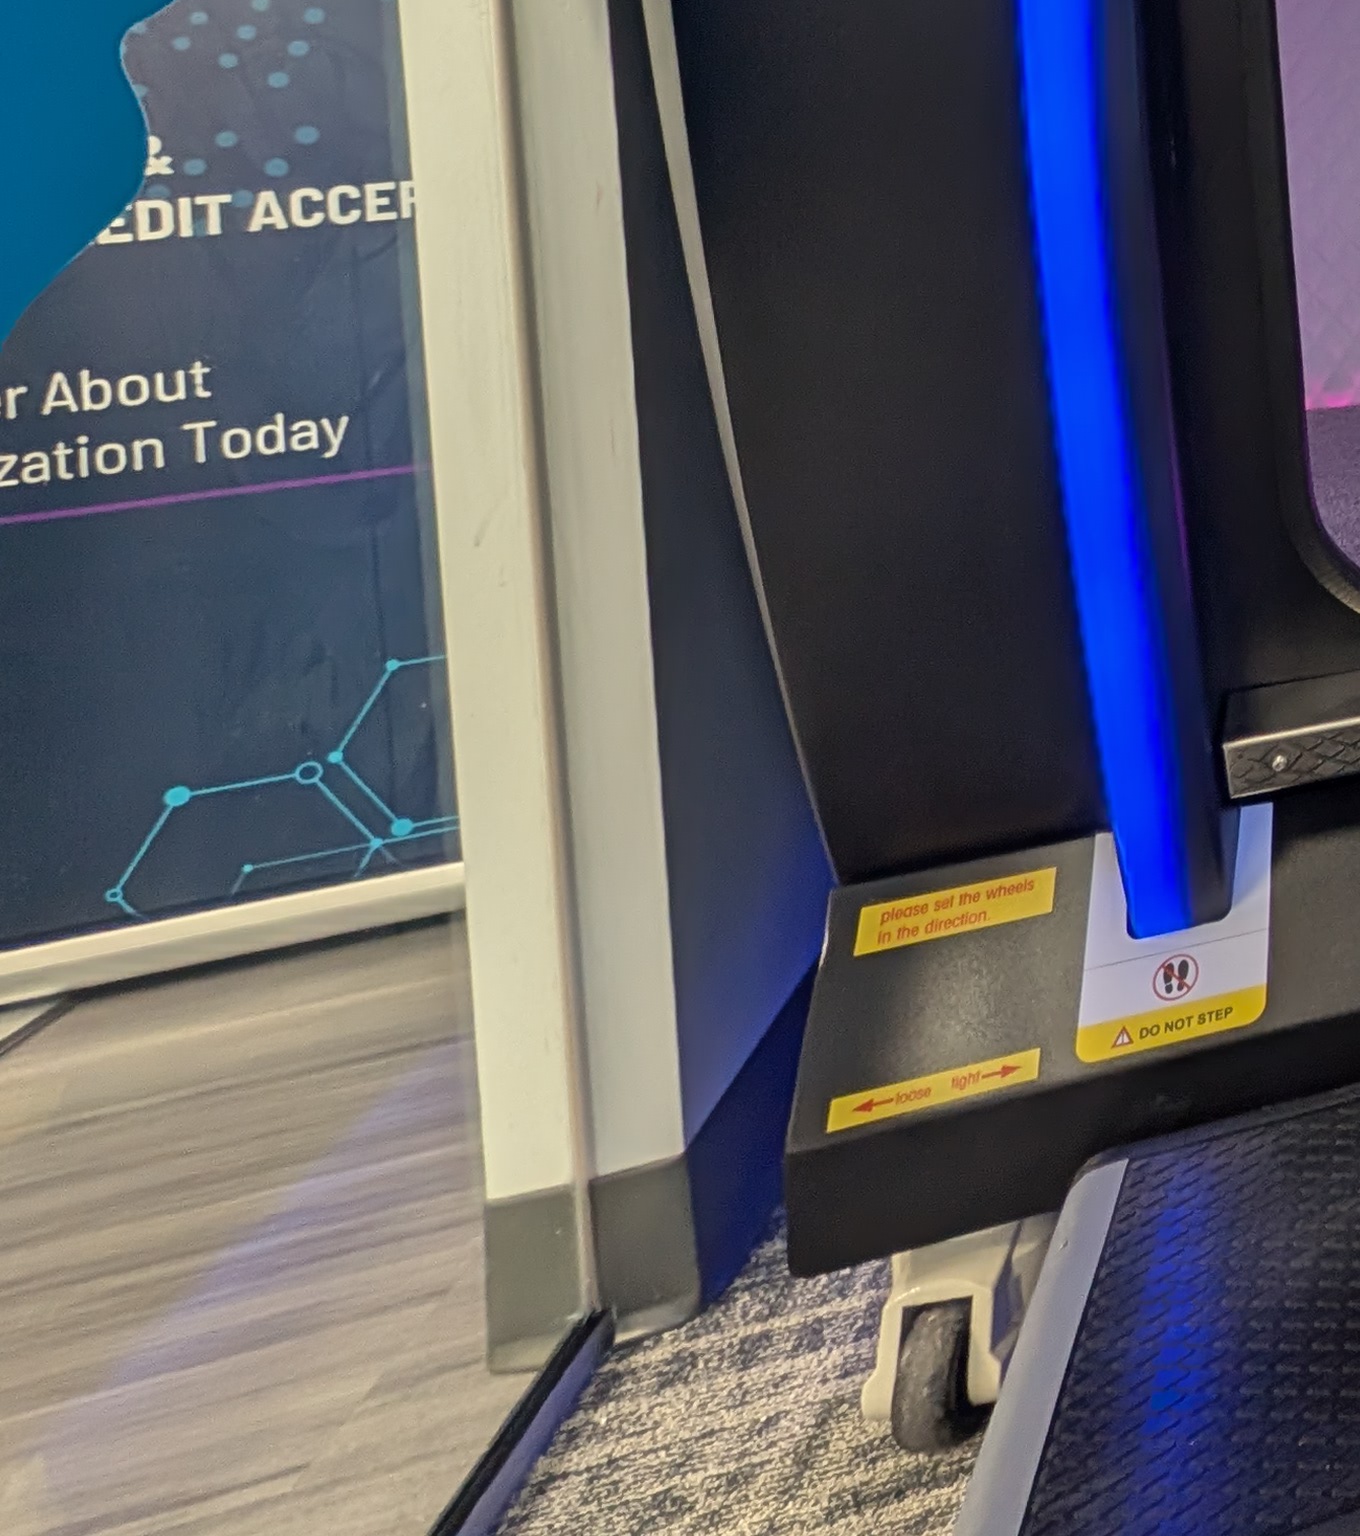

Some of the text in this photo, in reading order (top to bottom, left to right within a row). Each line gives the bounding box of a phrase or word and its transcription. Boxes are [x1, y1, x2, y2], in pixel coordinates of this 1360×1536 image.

[41, 360, 212, 416] About
[181, 412, 350, 465] Today
[879, 878, 1035, 926] please set the wheels
[897, 925, 919, 940] the
[1138, 1005, 1234, 1041] DO NOT STEP
[895, 1087, 932, 1106] loose
[951, 1071, 981, 1091] tight
